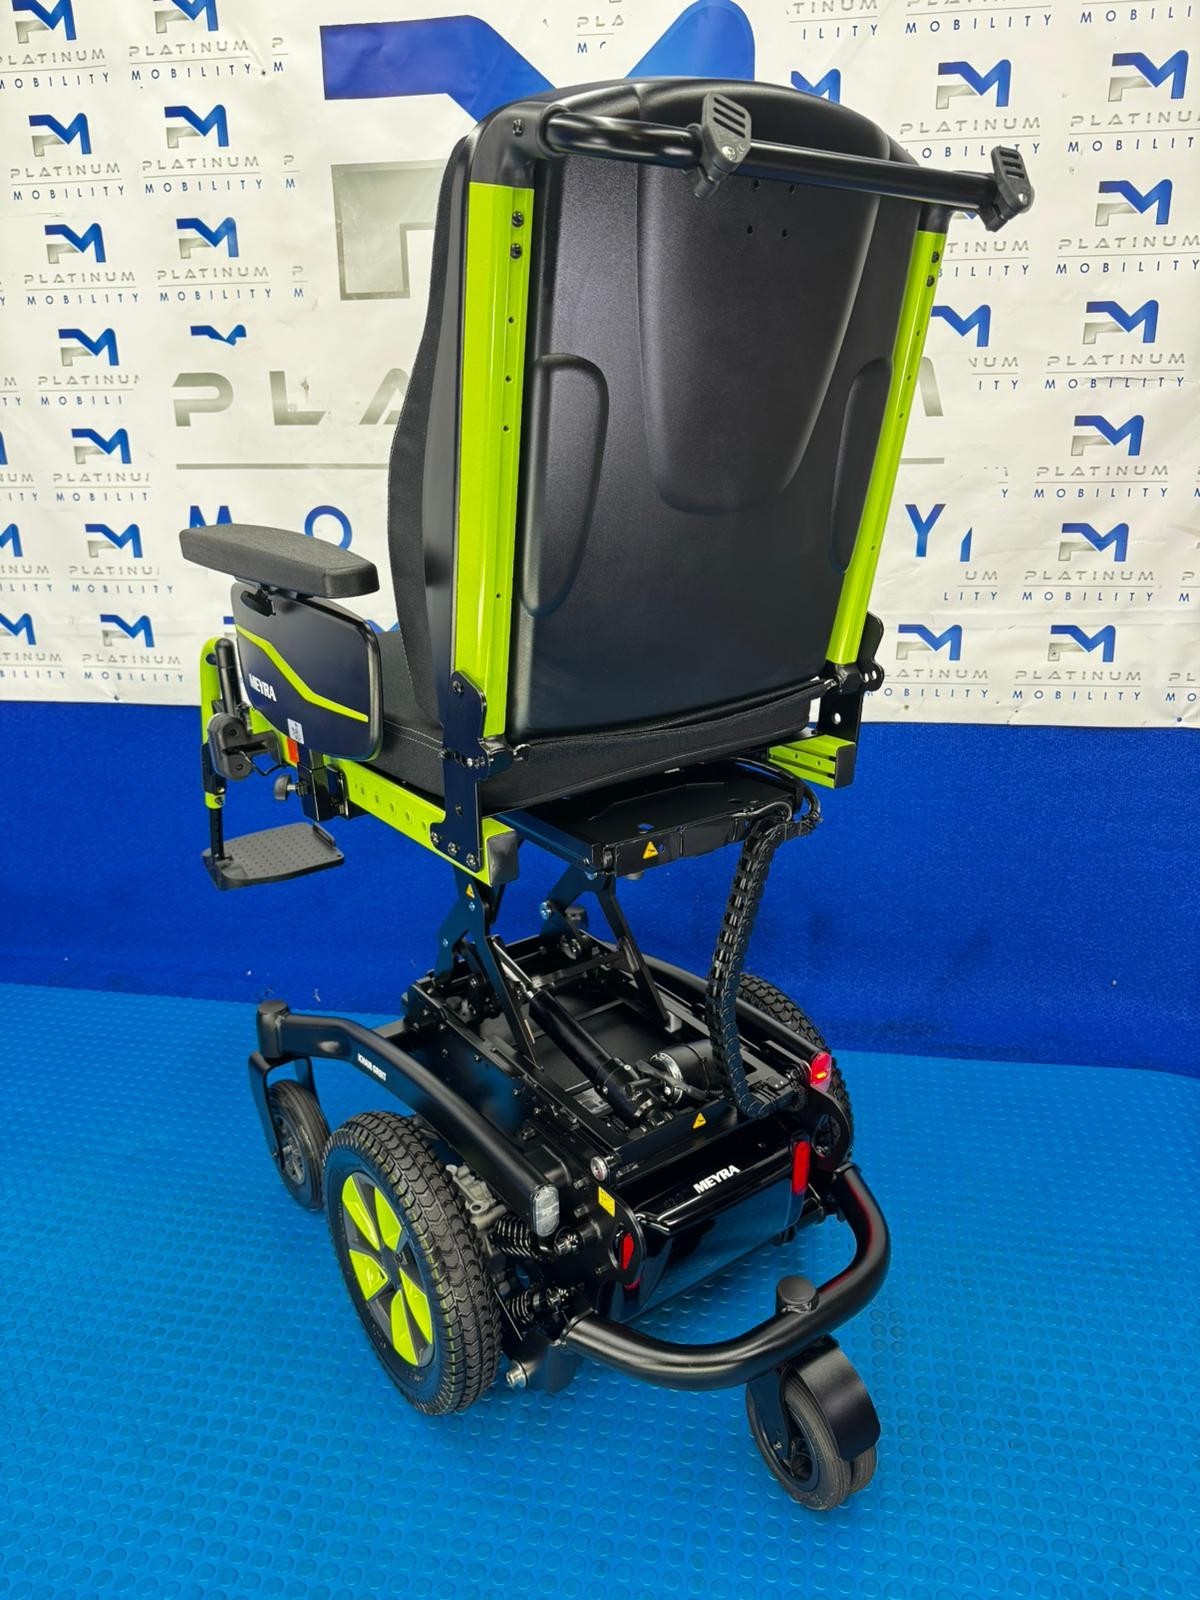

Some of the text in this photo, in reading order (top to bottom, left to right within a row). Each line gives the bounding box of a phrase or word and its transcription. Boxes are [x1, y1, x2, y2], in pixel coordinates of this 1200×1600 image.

[905, 14, 1051, 34] MOBILITY
[129, 40, 249, 56] PLATINUM
[132, 63, 251, 80] MOBILITY
[900, 117, 1040, 134] PLATINUM
[1070, 111, 1200, 127] PLATINU
[142, 156, 260, 171] PLATINUM
[10, 163, 120, 178] PLATINUM
[145, 179, 262, 193] MOBILITY
[14, 186, 124, 200] MOBILITY
[1058, 235, 1200, 250] PLATINUM
[157, 266, 269, 280] PLATINUM
[1056, 260, 1200, 274] MOBILITY
[24, 272, 135, 284] PLATINUM
[27, 294, 138, 305] MOBILITY
[160, 289, 271, 301] MOBILITY
[1047, 353, 1185, 366] PLATINUM
[1045, 376, 1184, 389] MOBILITY
[1036, 465, 1168, 476] PLATINUM
[1034, 488, 1168, 498] MOBILITY
[1024, 570, 1154, 581] PLATINUM
[72, 585, 174, 593] MOBILITY
[1022, 592, 1153, 601] MOBILITY
[82, 654, 181, 665] PLATINUM
[84, 672, 184, 682] MOBILITY
[1015, 671, 1141, 681] PLATINUM
[1013, 690, 1141, 700] MOBILITY
[693, 1165, 740, 1194] MEYRA
